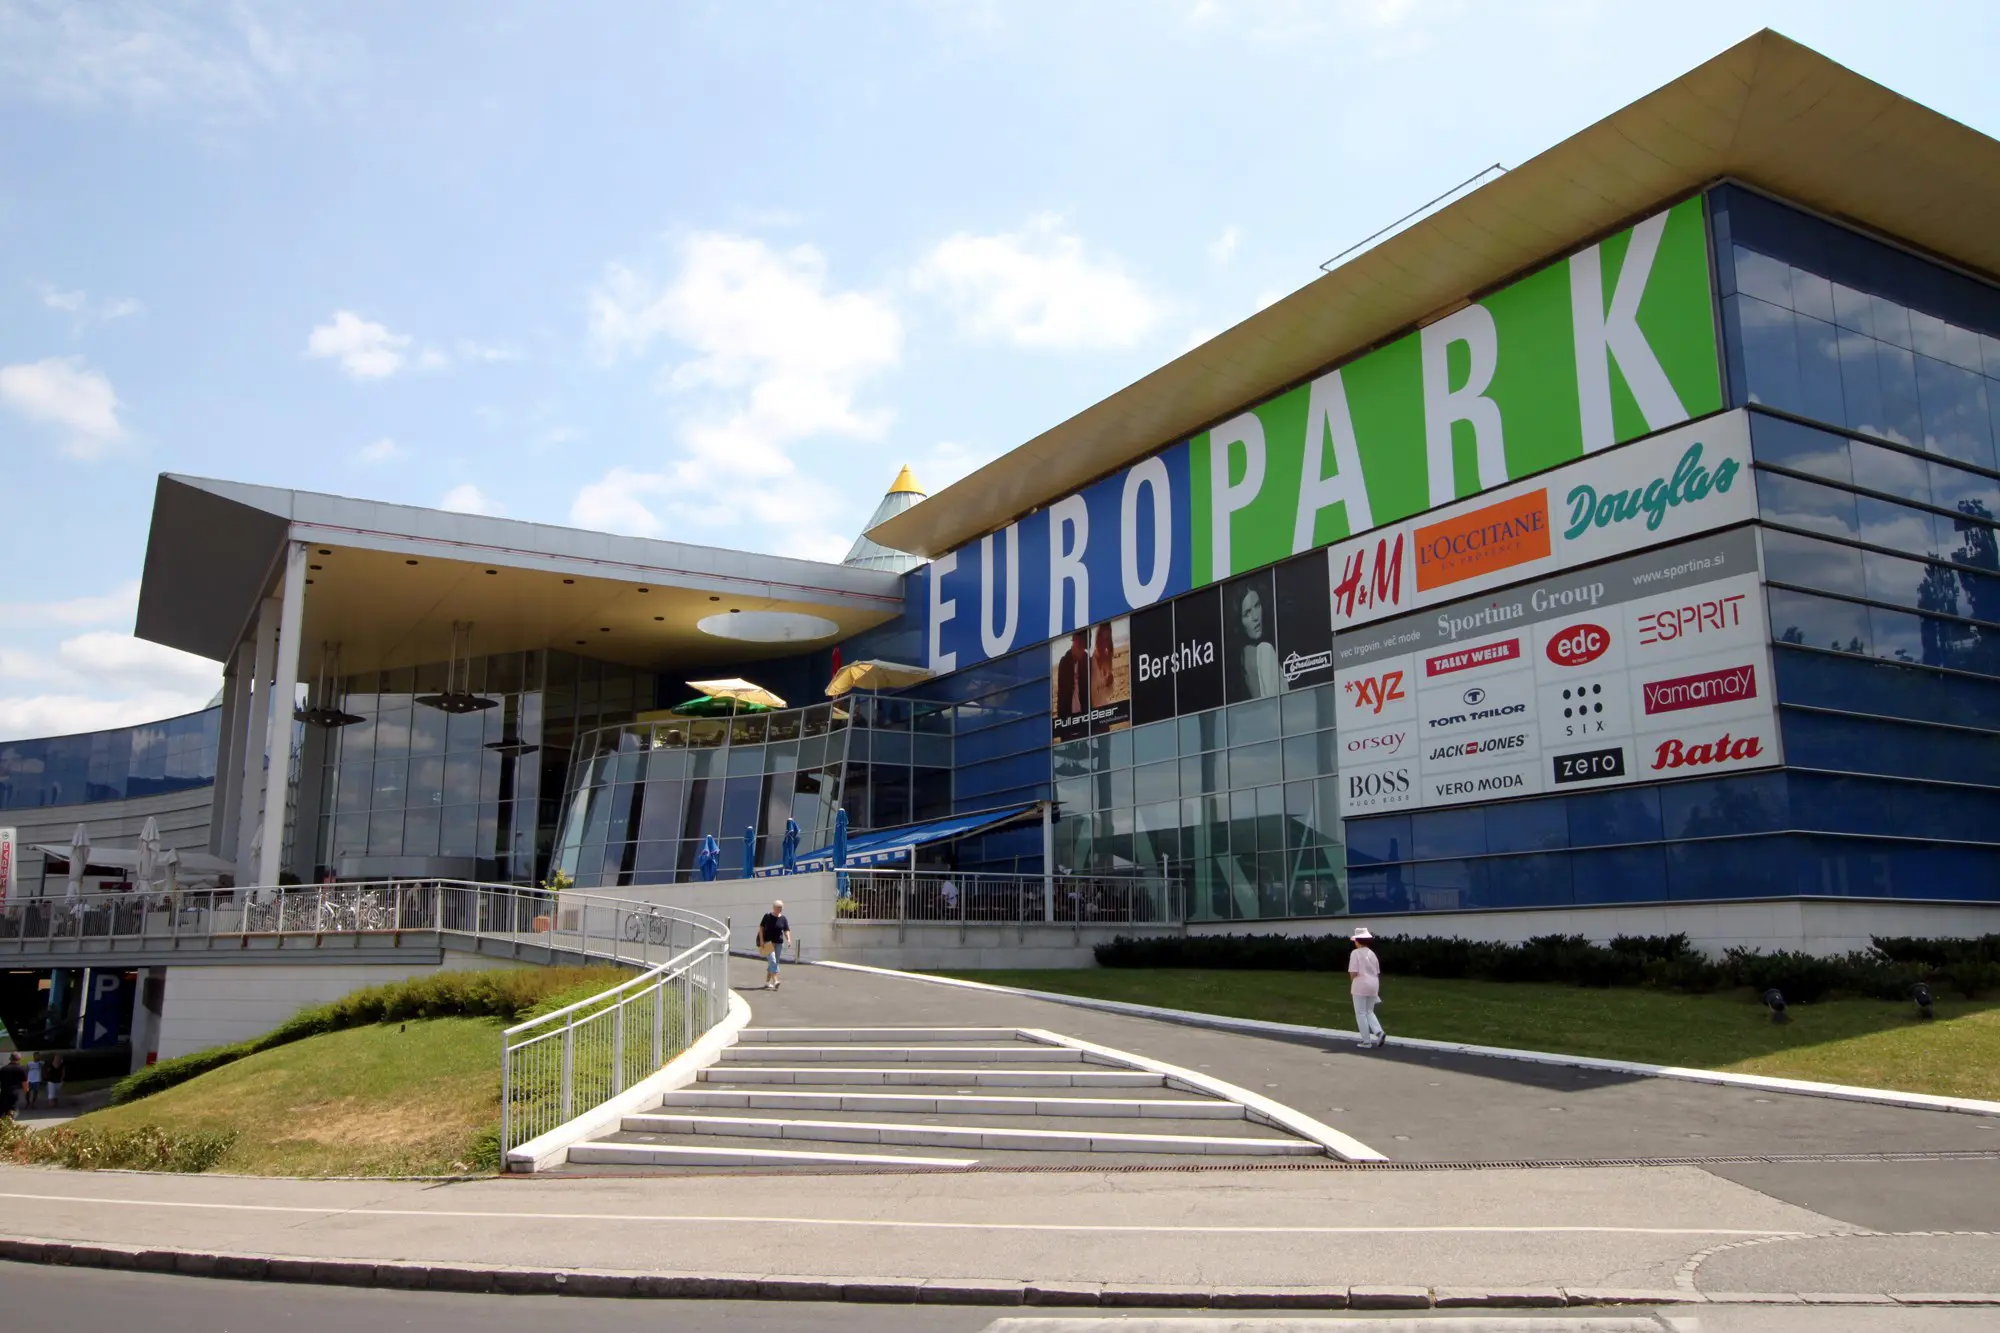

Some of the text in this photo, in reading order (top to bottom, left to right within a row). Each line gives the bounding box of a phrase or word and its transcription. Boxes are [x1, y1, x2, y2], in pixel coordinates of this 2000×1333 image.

[927, 209, 1691, 675] EUROPARK
[1564, 442, 1740, 540] Douglas
[1420, 510, 1545, 565] L'OCCITANE
[1333, 533, 1404, 618] H&M
[1632, 552, 1725, 585] www.sportina.si
[1438, 582, 1604, 640] Sportina Group
[1638, 595, 1745, 645] ESPRIT
[1398, 629, 1421, 644] mode
[1557, 629, 1601, 657] edc
[1139, 639, 1214, 682] Bershka
[1434, 654, 1470, 671] TALLY
[1646, 668, 1752, 711] yamamay
[1090, 707, 1119, 720] Bear
[1470, 704, 1525, 721] TAILOR
[1566, 720, 1604, 736] SIX
[1348, 732, 1406, 754] orsay
[1429, 734, 1525, 760] JACK JONES
[1651, 733, 1764, 770] Bata
[1563, 755, 1616, 776] zero
[1348, 768, 1410, 798] BOSS
[1436, 774, 1523, 796] VERO MODA
[94, 974, 120, 1001] P
